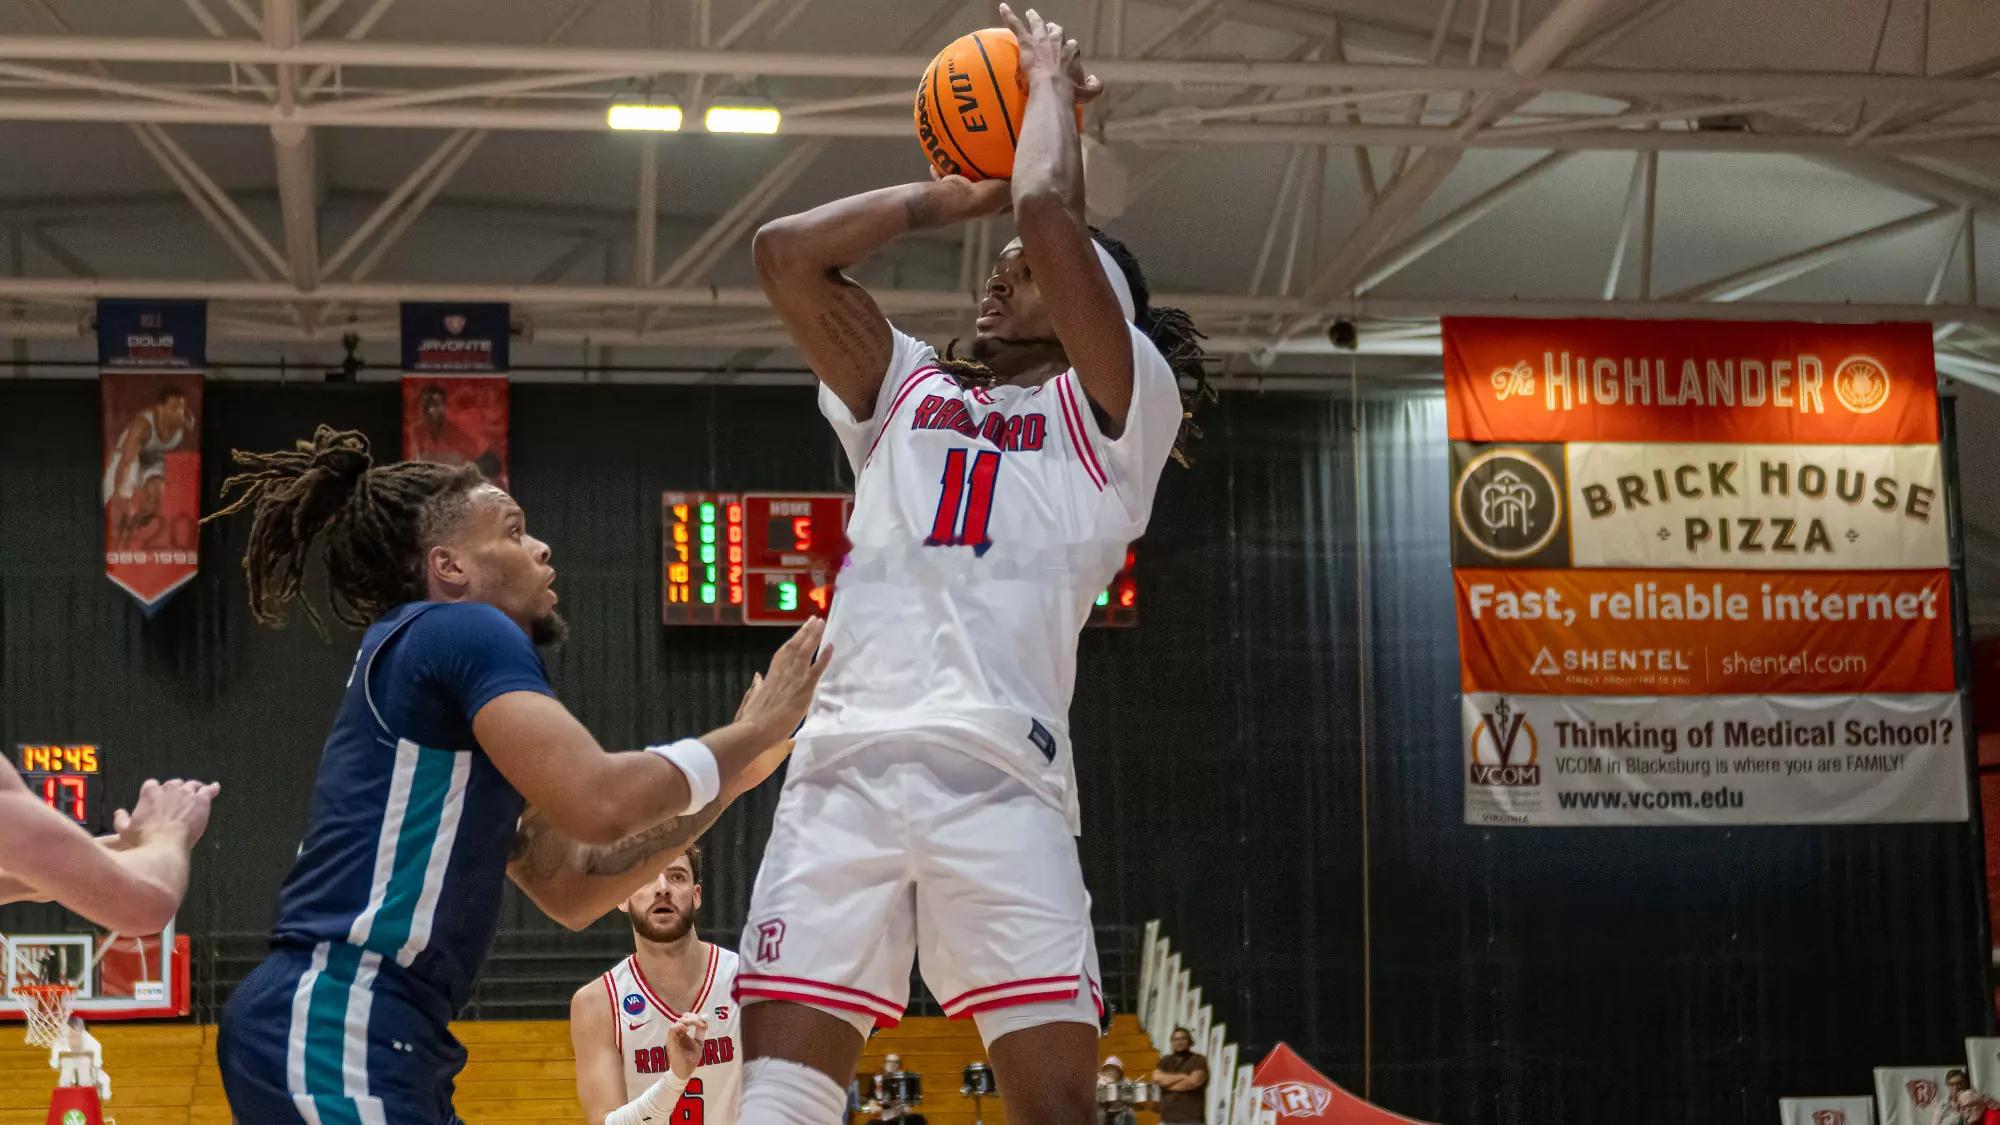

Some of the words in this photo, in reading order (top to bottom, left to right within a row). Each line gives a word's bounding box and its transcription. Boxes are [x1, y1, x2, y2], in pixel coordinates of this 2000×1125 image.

[1491, 360, 1536, 401] The
[924, 448, 1001, 549] 11
[1581, 461, 1739, 520] BRICK
[1760, 461, 1936, 523] HOUSE
[793, 517, 813, 551] 5
[1685, 516, 1836, 553] PIZZA
[706, 564, 716, 583] 1
[728, 565, 742, 583] 2
[668, 584, 689, 603] 11
[777, 582, 798, 611] 3
[1469, 584, 1577, 627] Fast,
[1589, 582, 1749, 621] reliable
[1761, 583, 1938, 621] internet
[1563, 649, 1690, 671] SHENTEL
[1721, 650, 1868, 675] shentel.com
[1554, 721, 1677, 753] Thinking
[1687, 720, 1715, 748] of
[1724, 720, 1836, 749] Medical
[1844, 719, 1954, 748] School?
[23, 744, 99, 773] 14:45
[1556, 757, 1601, 775] VCOM
[1607, 757, 1621, 774] in
[1627, 755, 1711, 777] Blacksburg
[1733, 755, 1781, 774] where
[1785, 758, 1813, 777] you
[1817, 758, 1842, 773] are
[1846, 753, 1905, 773] FAMILY!
[1474, 767, 1537, 786] VCOM
[43, 775, 87, 823] 17
[1558, 786, 1745, 810] www.vcom.edu
[755, 917, 787, 964] R
[627, 996, 640, 1005] VA
